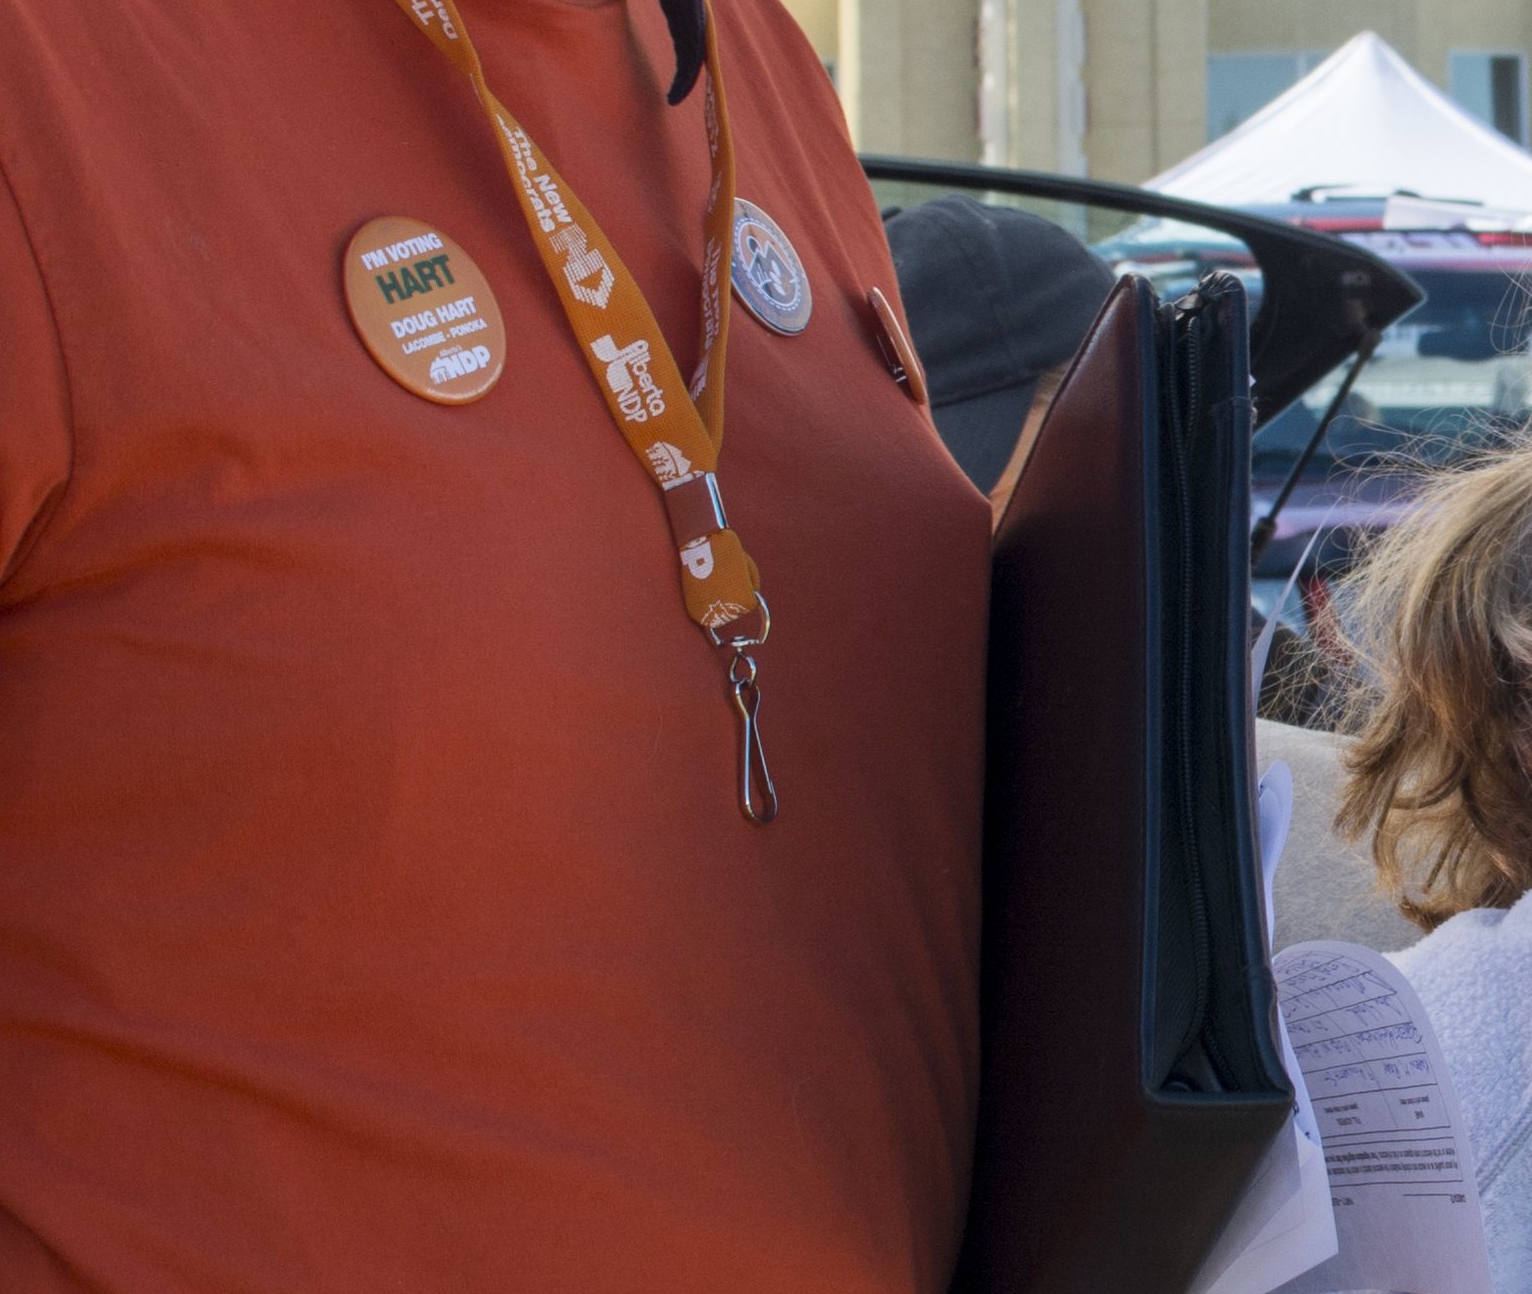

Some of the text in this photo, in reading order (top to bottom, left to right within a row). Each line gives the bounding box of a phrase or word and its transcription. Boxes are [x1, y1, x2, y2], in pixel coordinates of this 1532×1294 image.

[513, 126, 573, 223] The New
[360, 232, 443, 271] I'M VOTING
[374, 254, 456, 304] HART
[390, 296, 478, 339] DOUG HART
[447, 345, 491, 379] NDP
[618, 384, 648, 423] NDP
